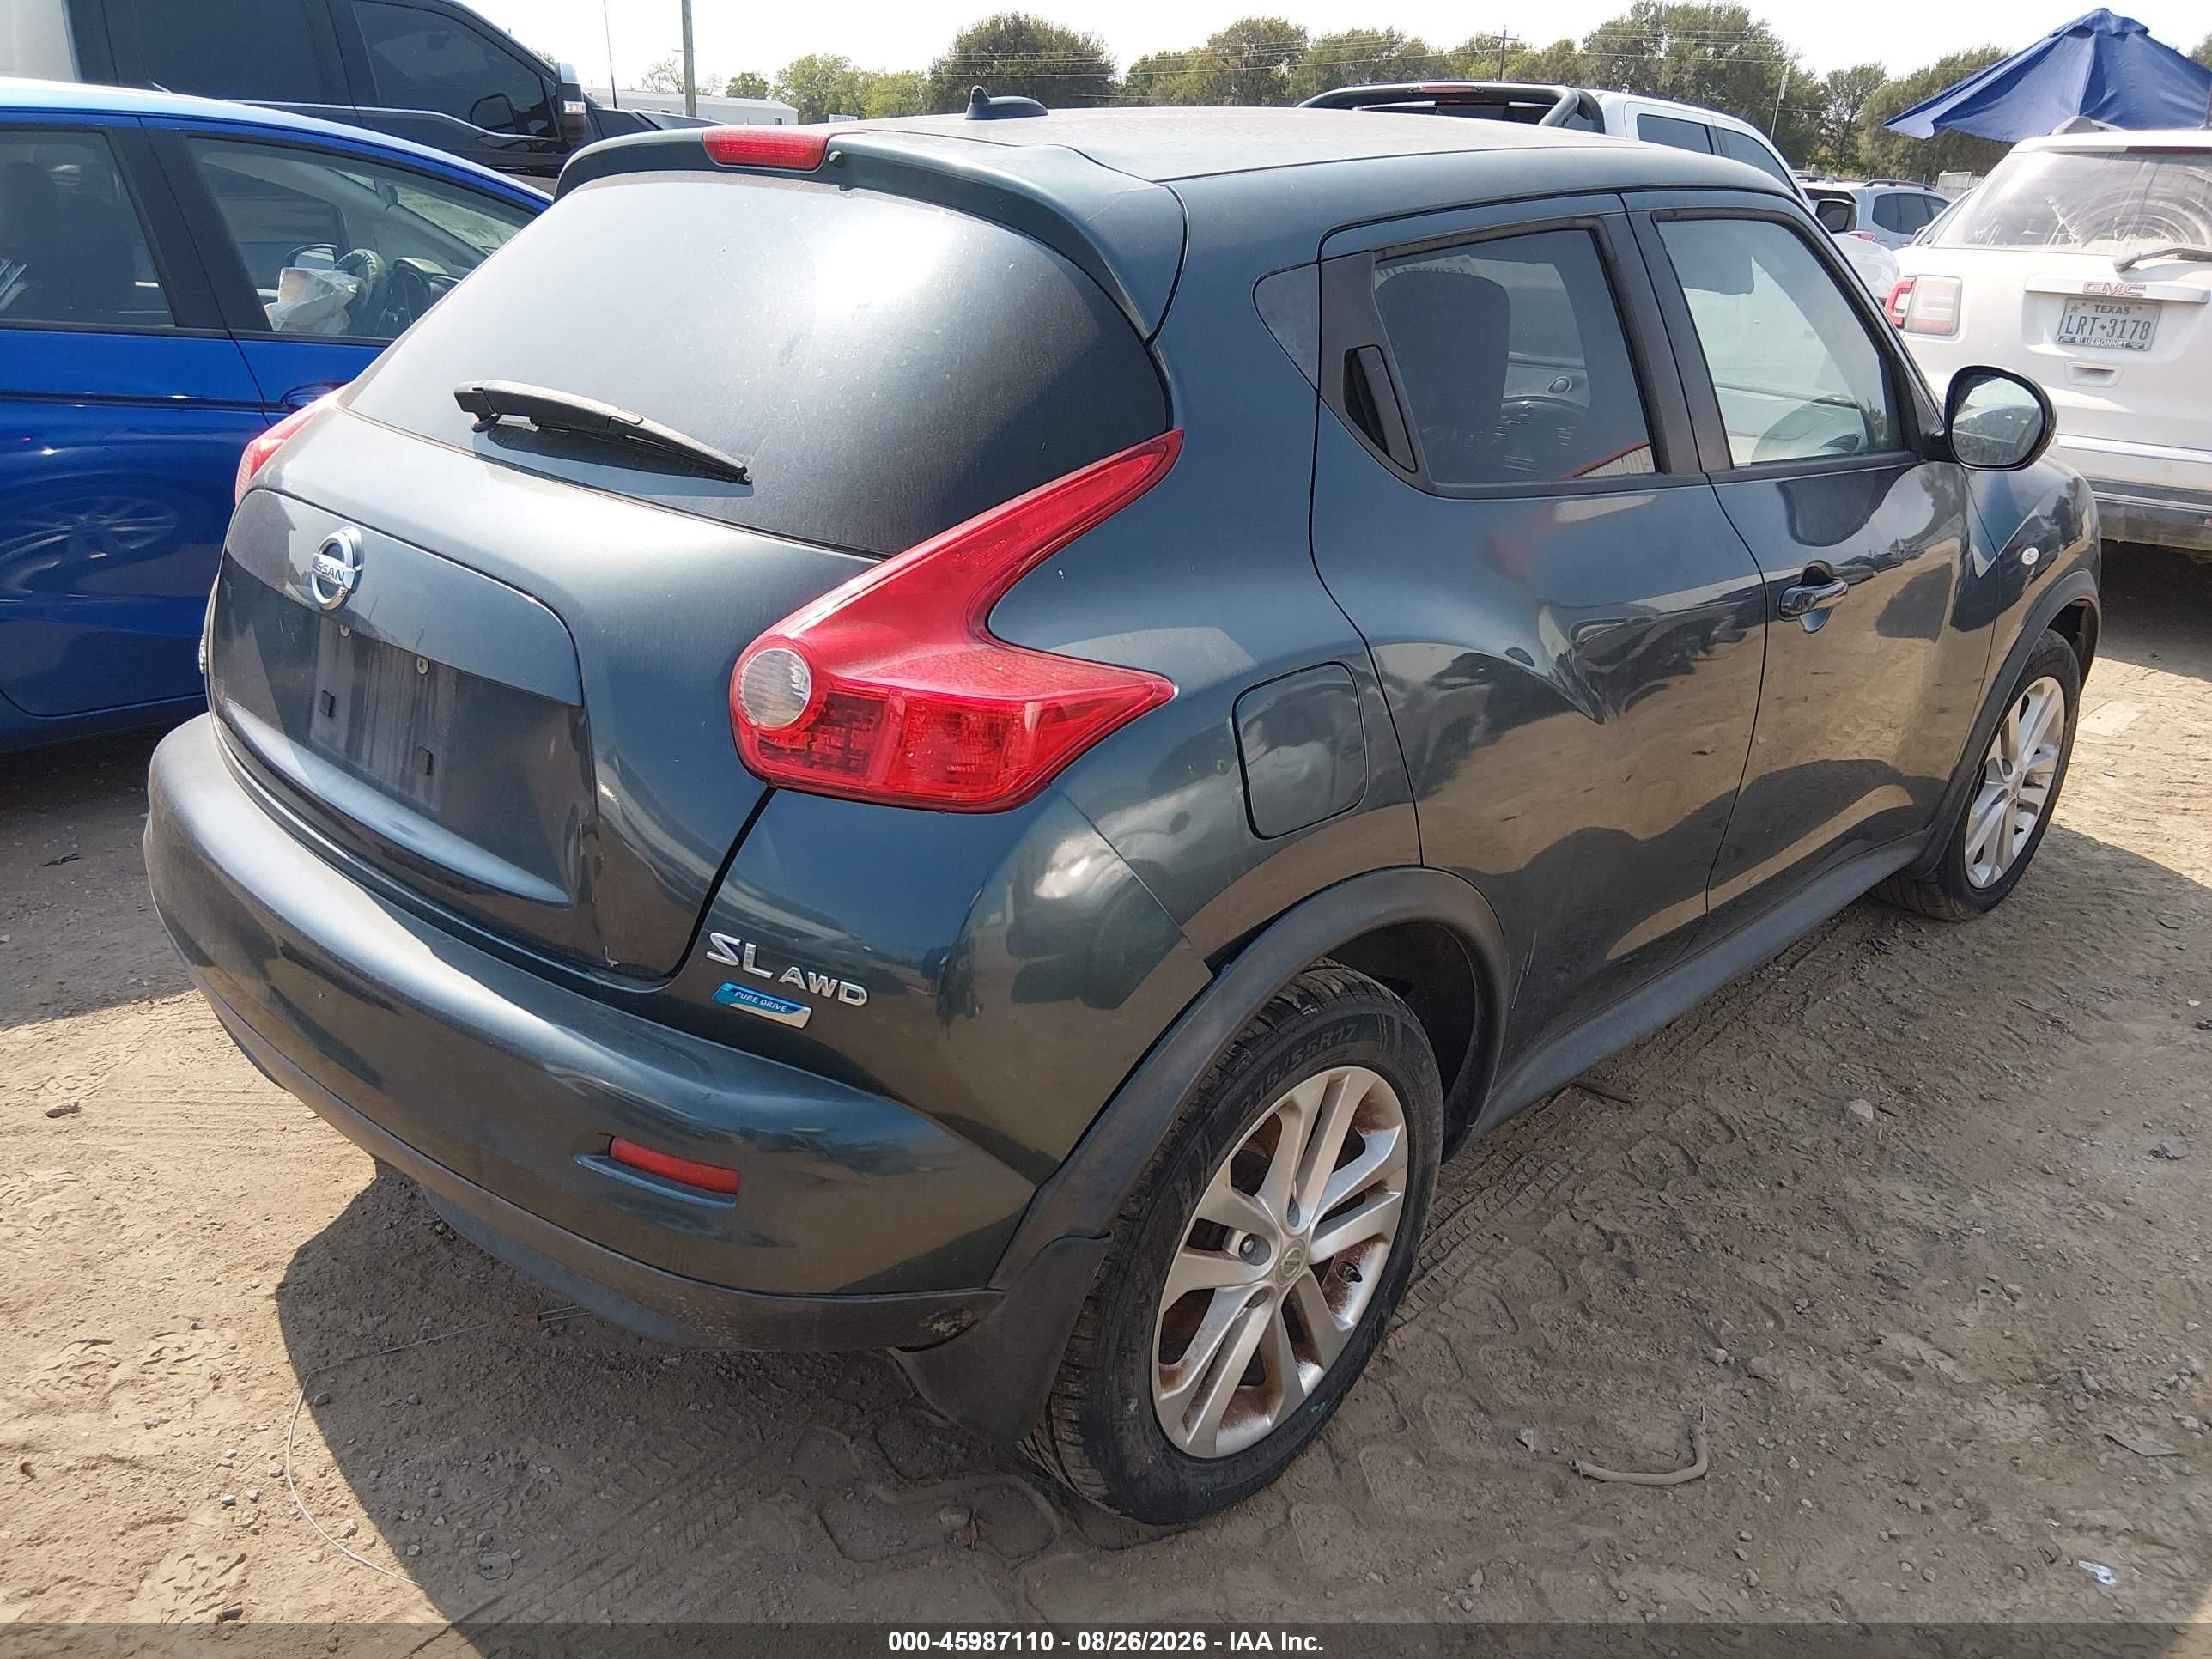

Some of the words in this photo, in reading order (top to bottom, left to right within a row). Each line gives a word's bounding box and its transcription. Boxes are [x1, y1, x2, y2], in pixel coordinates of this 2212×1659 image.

[2082, 281, 2147, 296] GMC
[2094, 304, 2130, 315] TEXAS
[2075, 337, 2129, 349] BLUEBONNET
[312, 556, 345, 582] ISSAN
[707, 932, 774, 979] SL
[777, 966, 869, 1006] AWD
[734, 991, 758, 1005] PURE
[759, 999, 787, 1012] DRIVE
